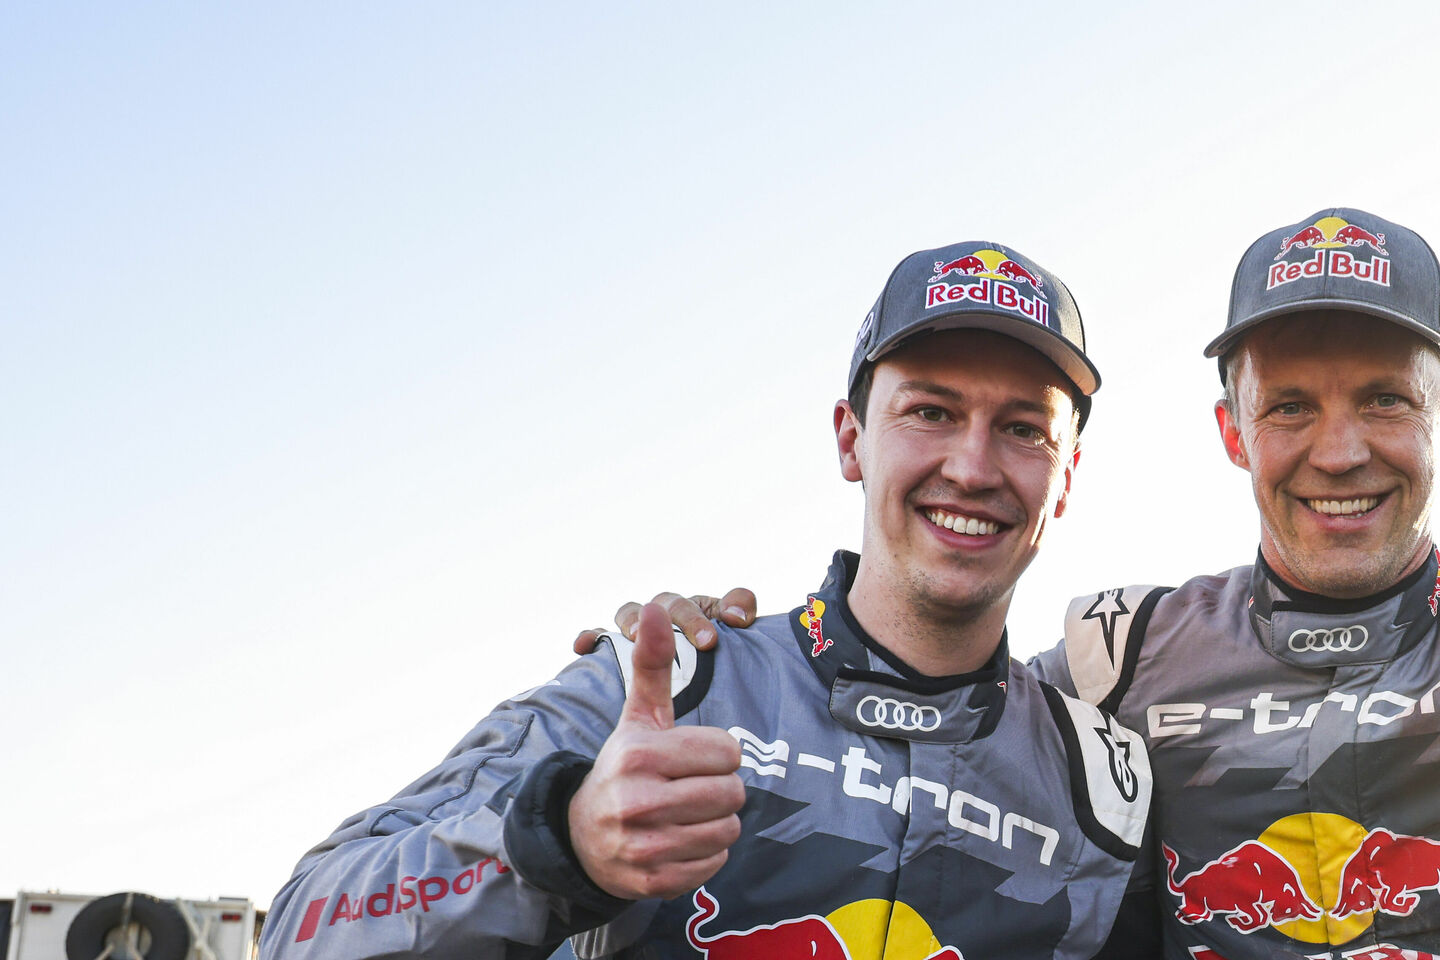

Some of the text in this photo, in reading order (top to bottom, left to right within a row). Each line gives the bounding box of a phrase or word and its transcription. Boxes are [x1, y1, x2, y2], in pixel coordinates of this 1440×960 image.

[1266, 249, 1390, 290] Red Bull
[925, 278, 1049, 328] Red Bull
[727, 726, 1060, 866] e-tron
[400, 856, 512, 912] Sport
